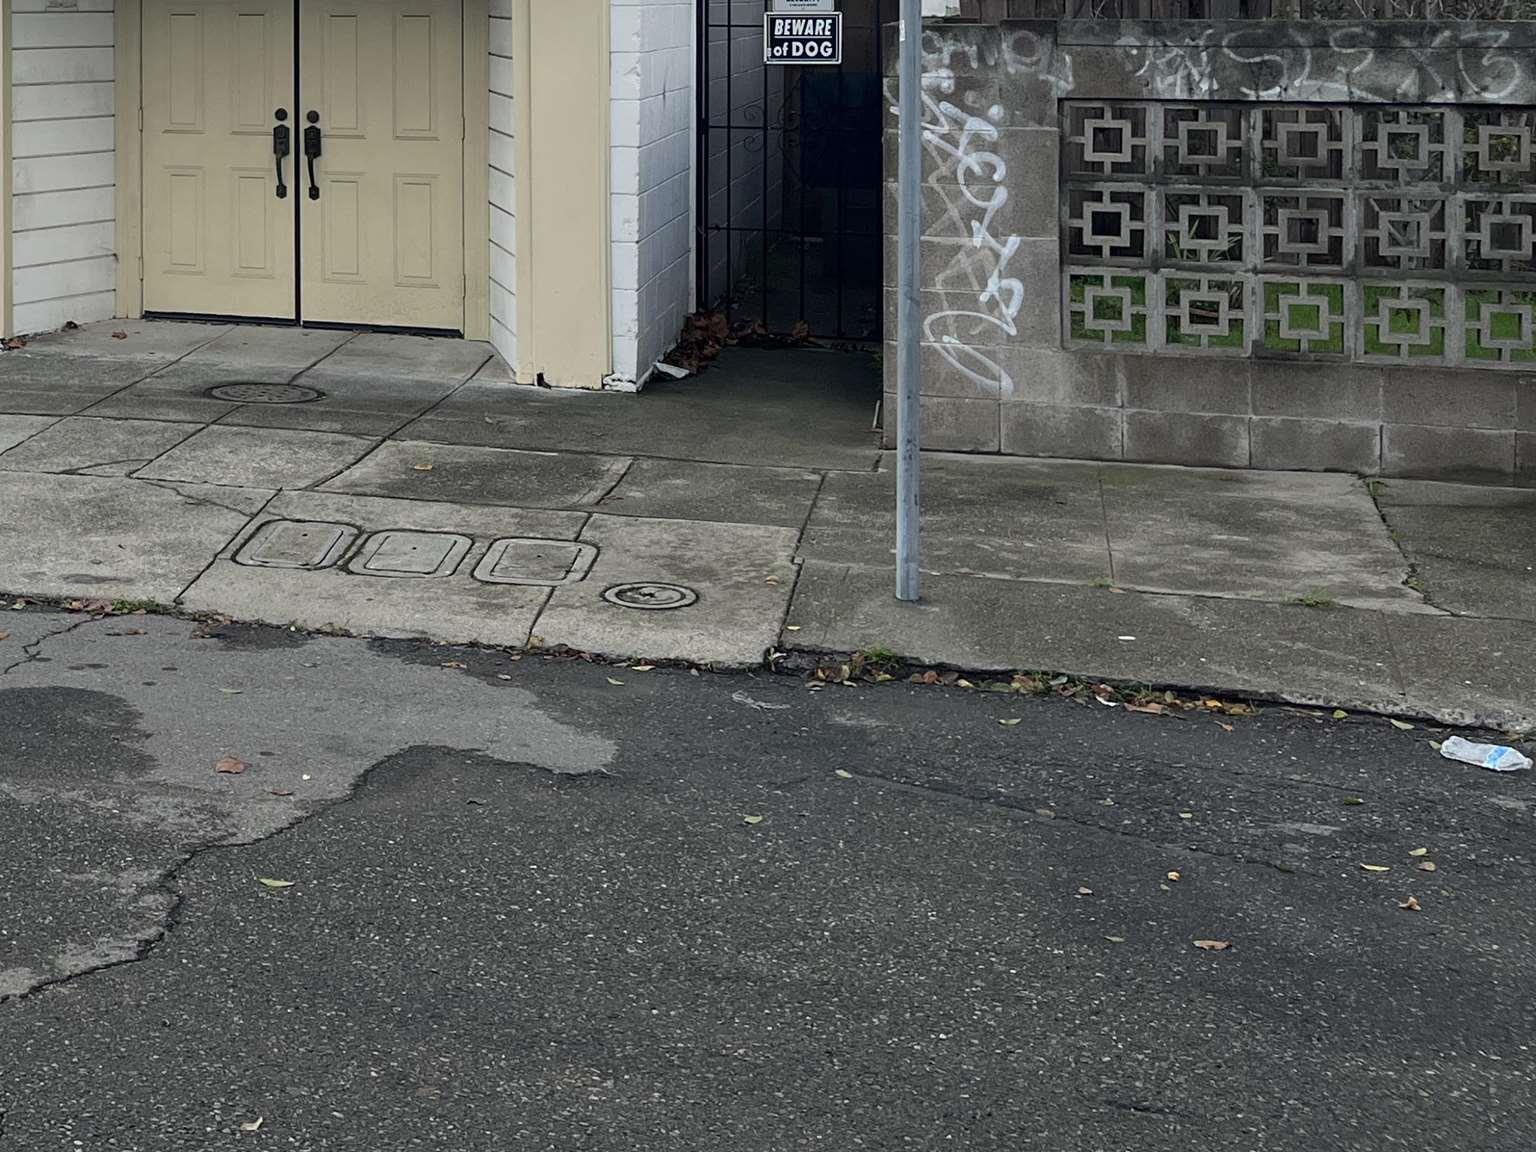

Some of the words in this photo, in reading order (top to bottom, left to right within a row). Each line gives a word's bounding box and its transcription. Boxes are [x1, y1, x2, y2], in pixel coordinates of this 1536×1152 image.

[774, 19, 833, 35] BEWARE
[773, 42, 789, 56] of
[792, 41, 833, 57] DOG
